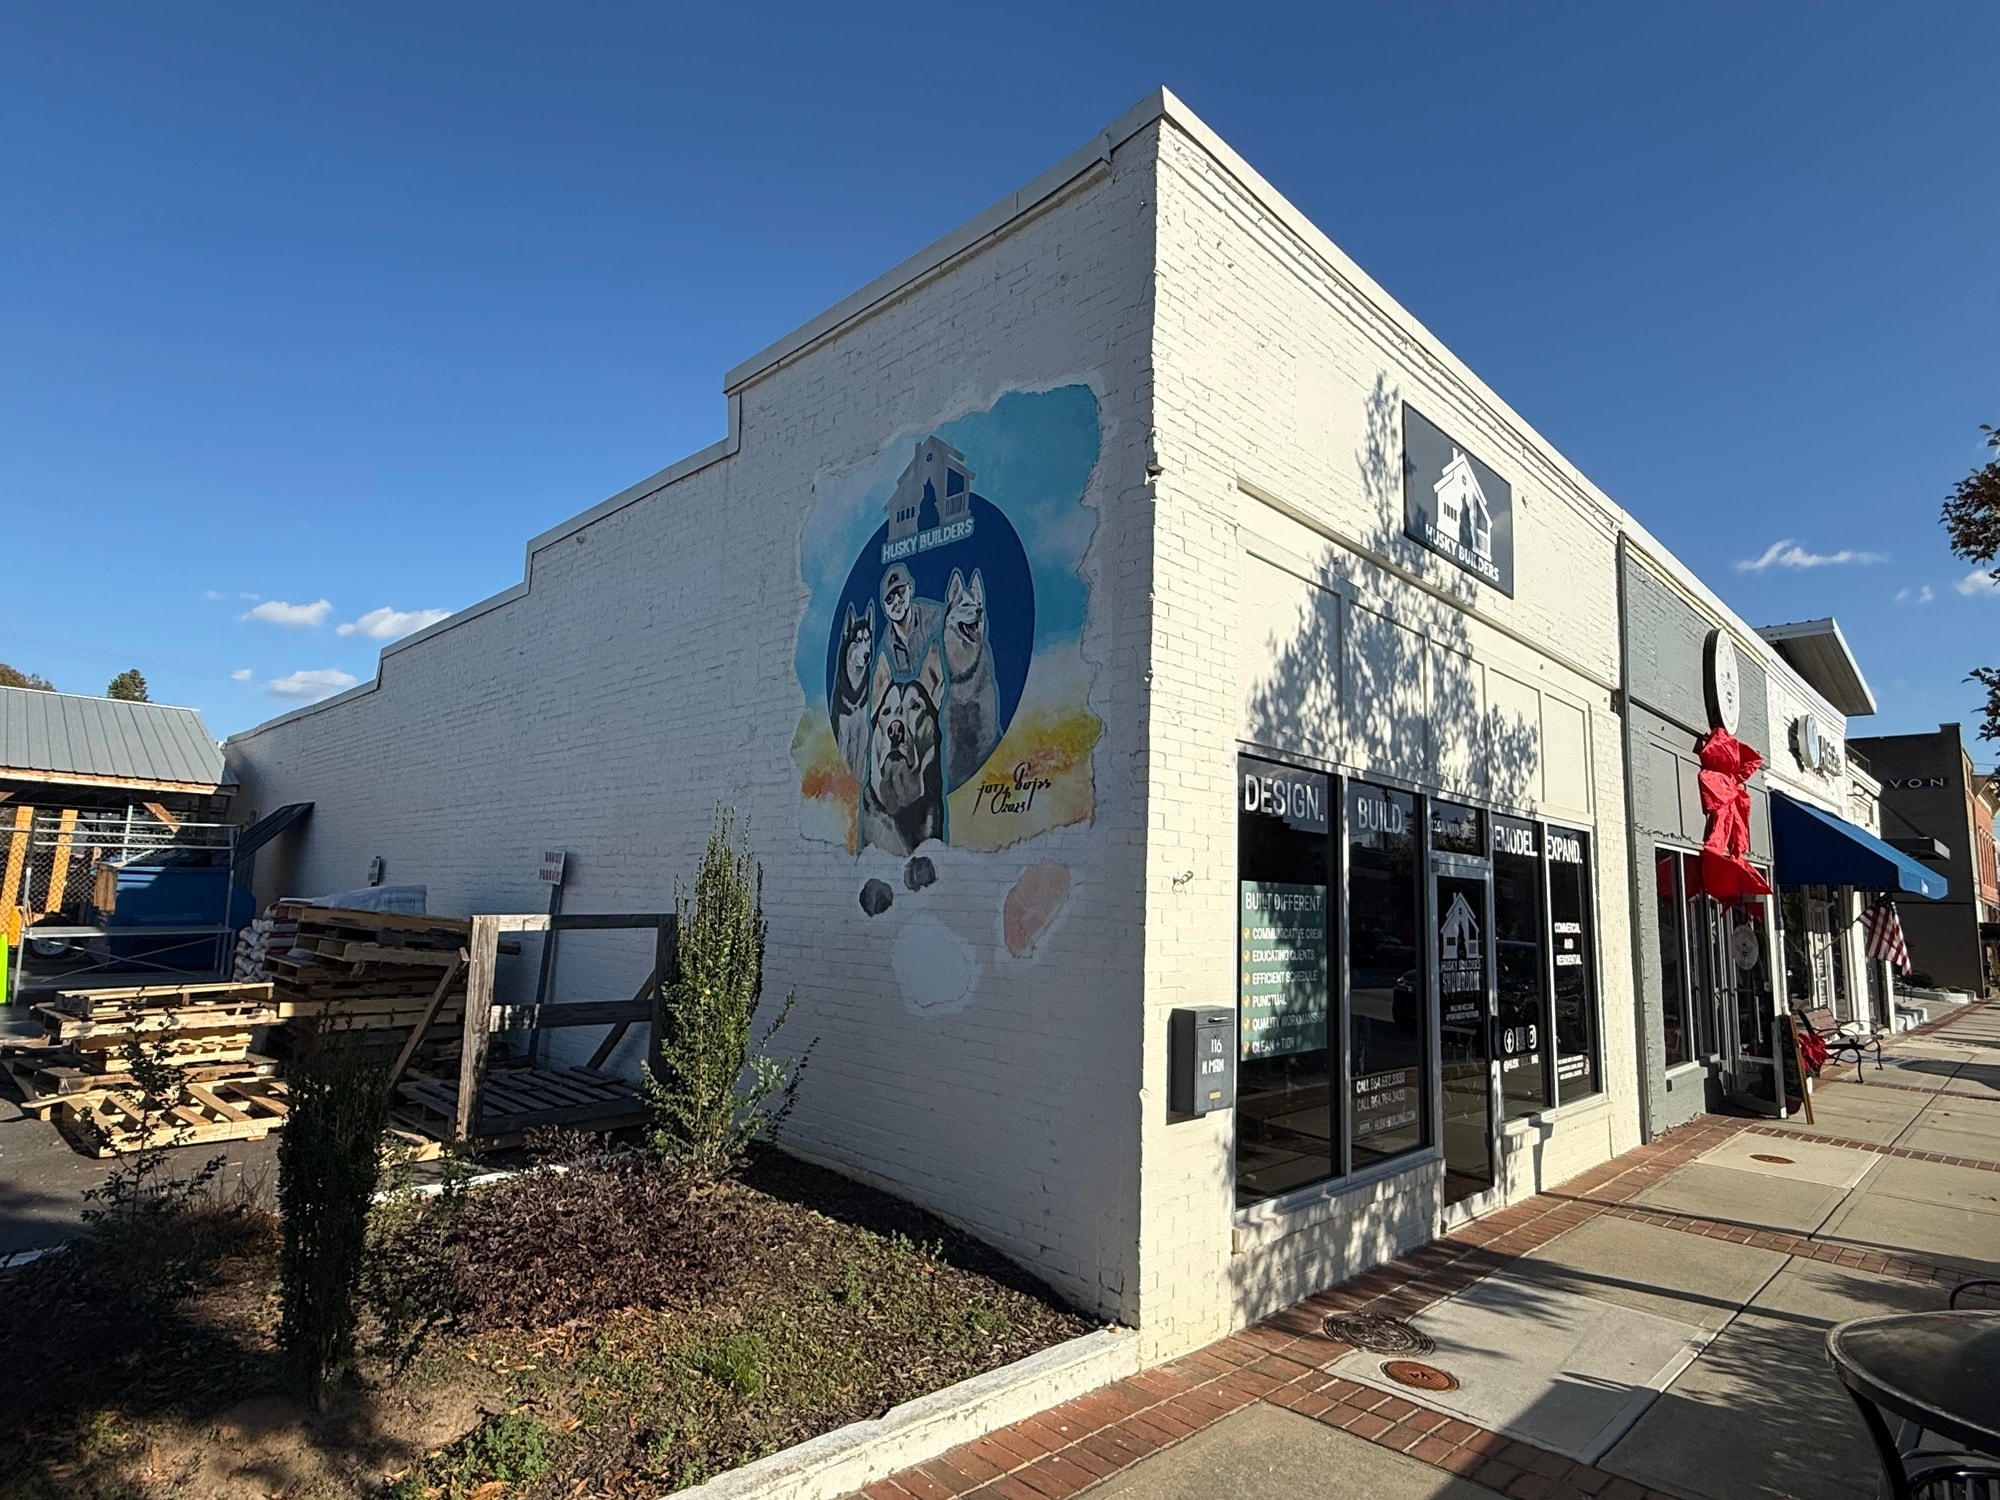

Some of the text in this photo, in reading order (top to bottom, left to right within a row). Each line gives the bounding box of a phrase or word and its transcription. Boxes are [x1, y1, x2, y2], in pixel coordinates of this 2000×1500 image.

[883, 518, 974, 561] HUSKY BUILDERS
[1425, 523, 1500, 582] HUSKY BUILDERS
[1244, 773, 1325, 822] DESIGN.
[1000, 801, 1026, 815] 2023
[1494, 825, 1538, 857] EMODEL.
[1546, 835, 1583, 865] EXPAND.
[1245, 891, 1324, 912] BUILT DIFFERENT.
[1252, 927, 1323, 940] COMMUNICATIVE CREW
[1252, 949, 1315, 963] EDUCATING CLIENTS
[1252, 970, 1318, 985] EFFICIENT SCHEDULE
[1442, 971, 1480, 994] SHOWROOM
[1252, 993, 1288, 1008] PUNCTUAL
[1252, 1016, 1280, 1032] QUALITY
[1211, 1039, 1222, 1053] 116
[1252, 1039, 1275, 1054] CLEAN
[1281, 1036, 1295, 1049] TIDY
[1209, 1058, 1224, 1073] MAIN
[1356, 1078, 1370, 1094] CALL
[1356, 1095, 1370, 1112] CALL
